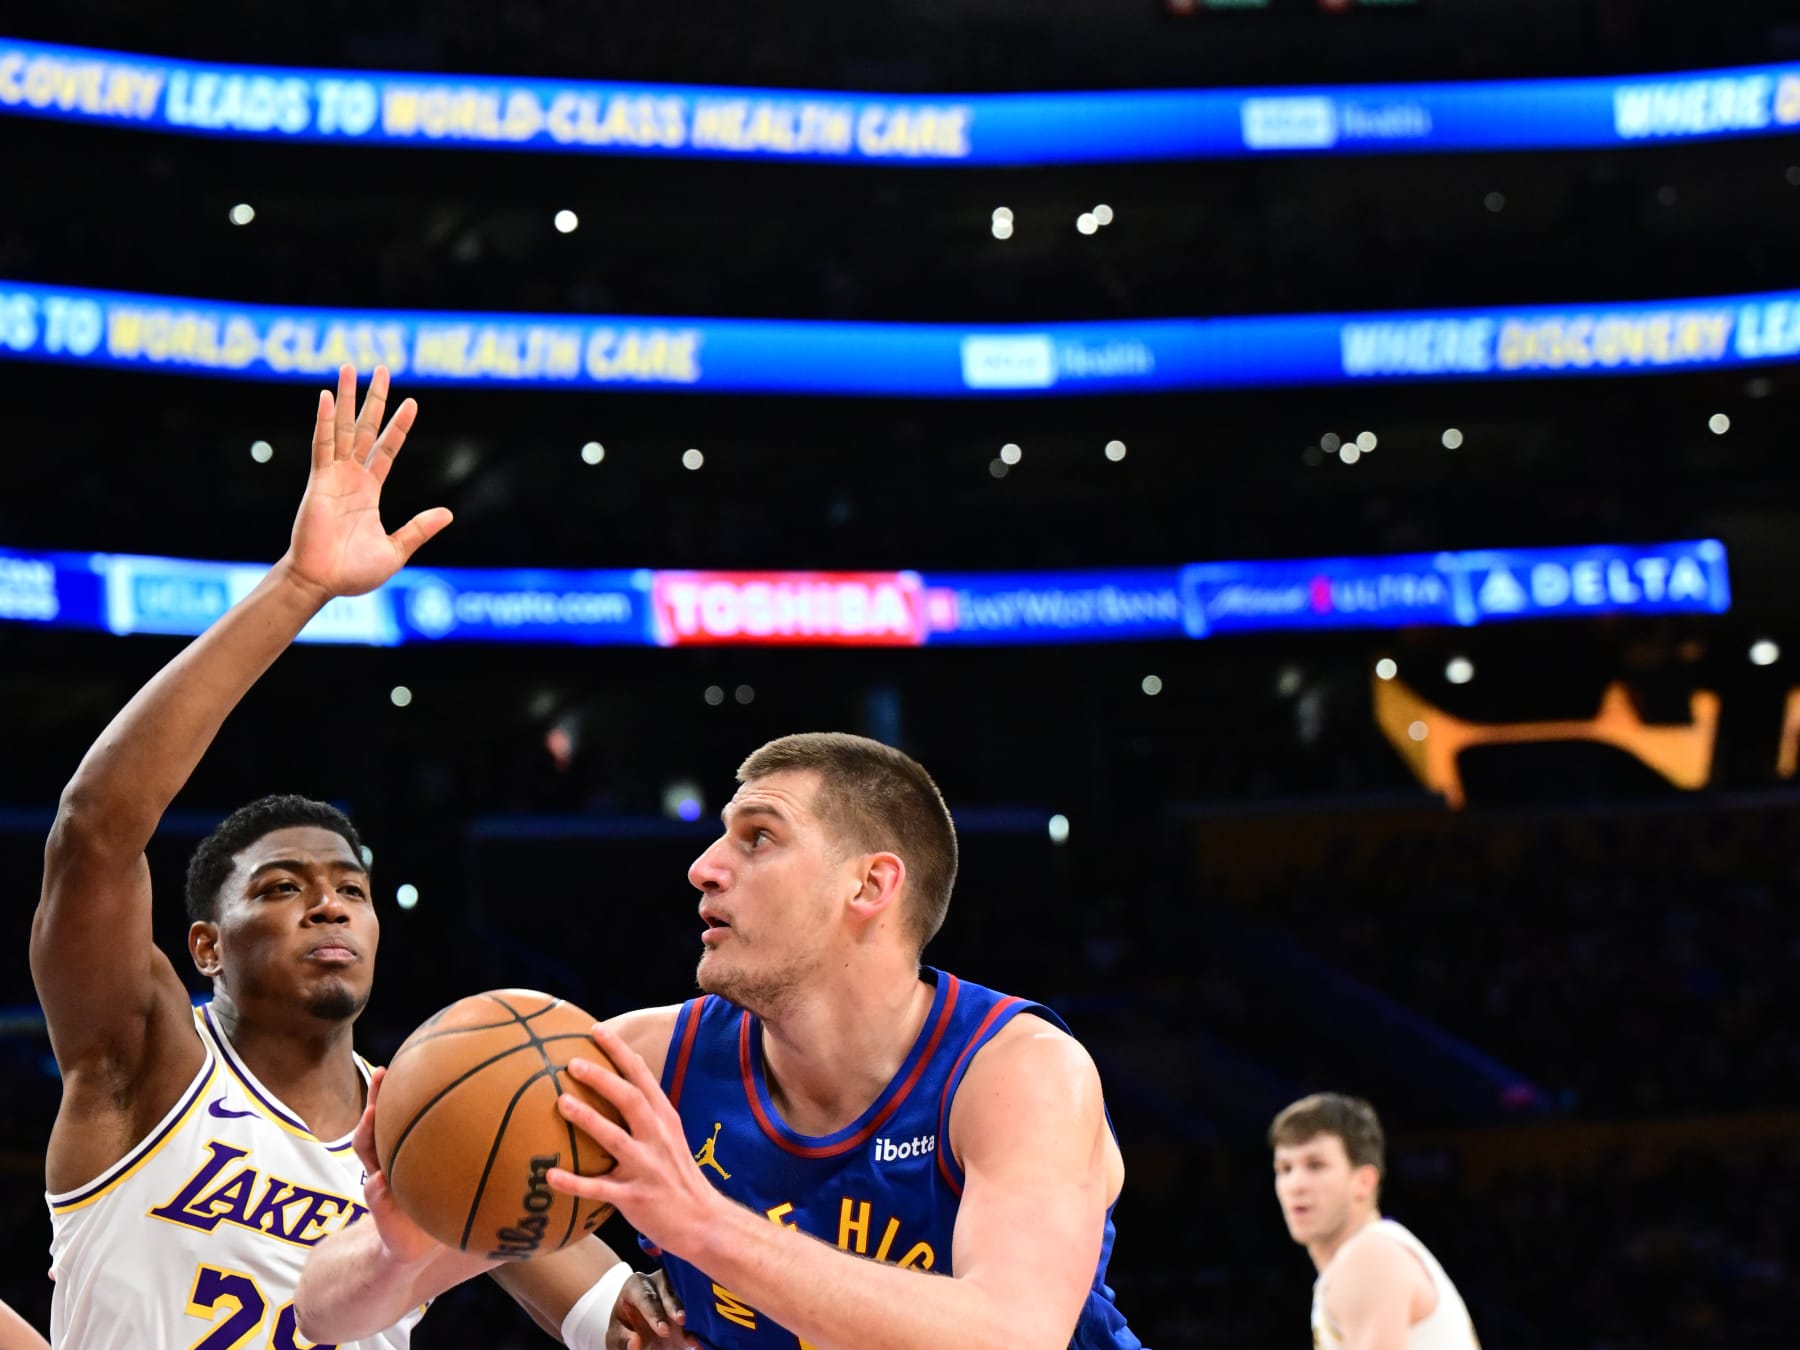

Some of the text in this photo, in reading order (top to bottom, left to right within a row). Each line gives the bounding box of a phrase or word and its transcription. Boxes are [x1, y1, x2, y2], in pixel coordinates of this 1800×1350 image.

[165, 70, 311, 135] LEADS
[314, 78, 377, 137] TO
[381, 84, 687, 149] WORLD-CLASS
[690, 101, 852, 156] HEALTH
[857, 104, 970, 158] CARE
[1613, 74, 1773, 139] WHERE
[0, 293, 702, 384] S TO WORLD-CLASS HEALTH CARE
[1339, 315, 1494, 377] WHERE
[1497, 306, 1734, 371] DISCOVERY
[667, 582, 912, 637] TOSHIBA
[1530, 556, 1710, 608] DELTA
[874, 1134, 935, 1162] ibotta
[146, 1137, 370, 1250] LAKE
